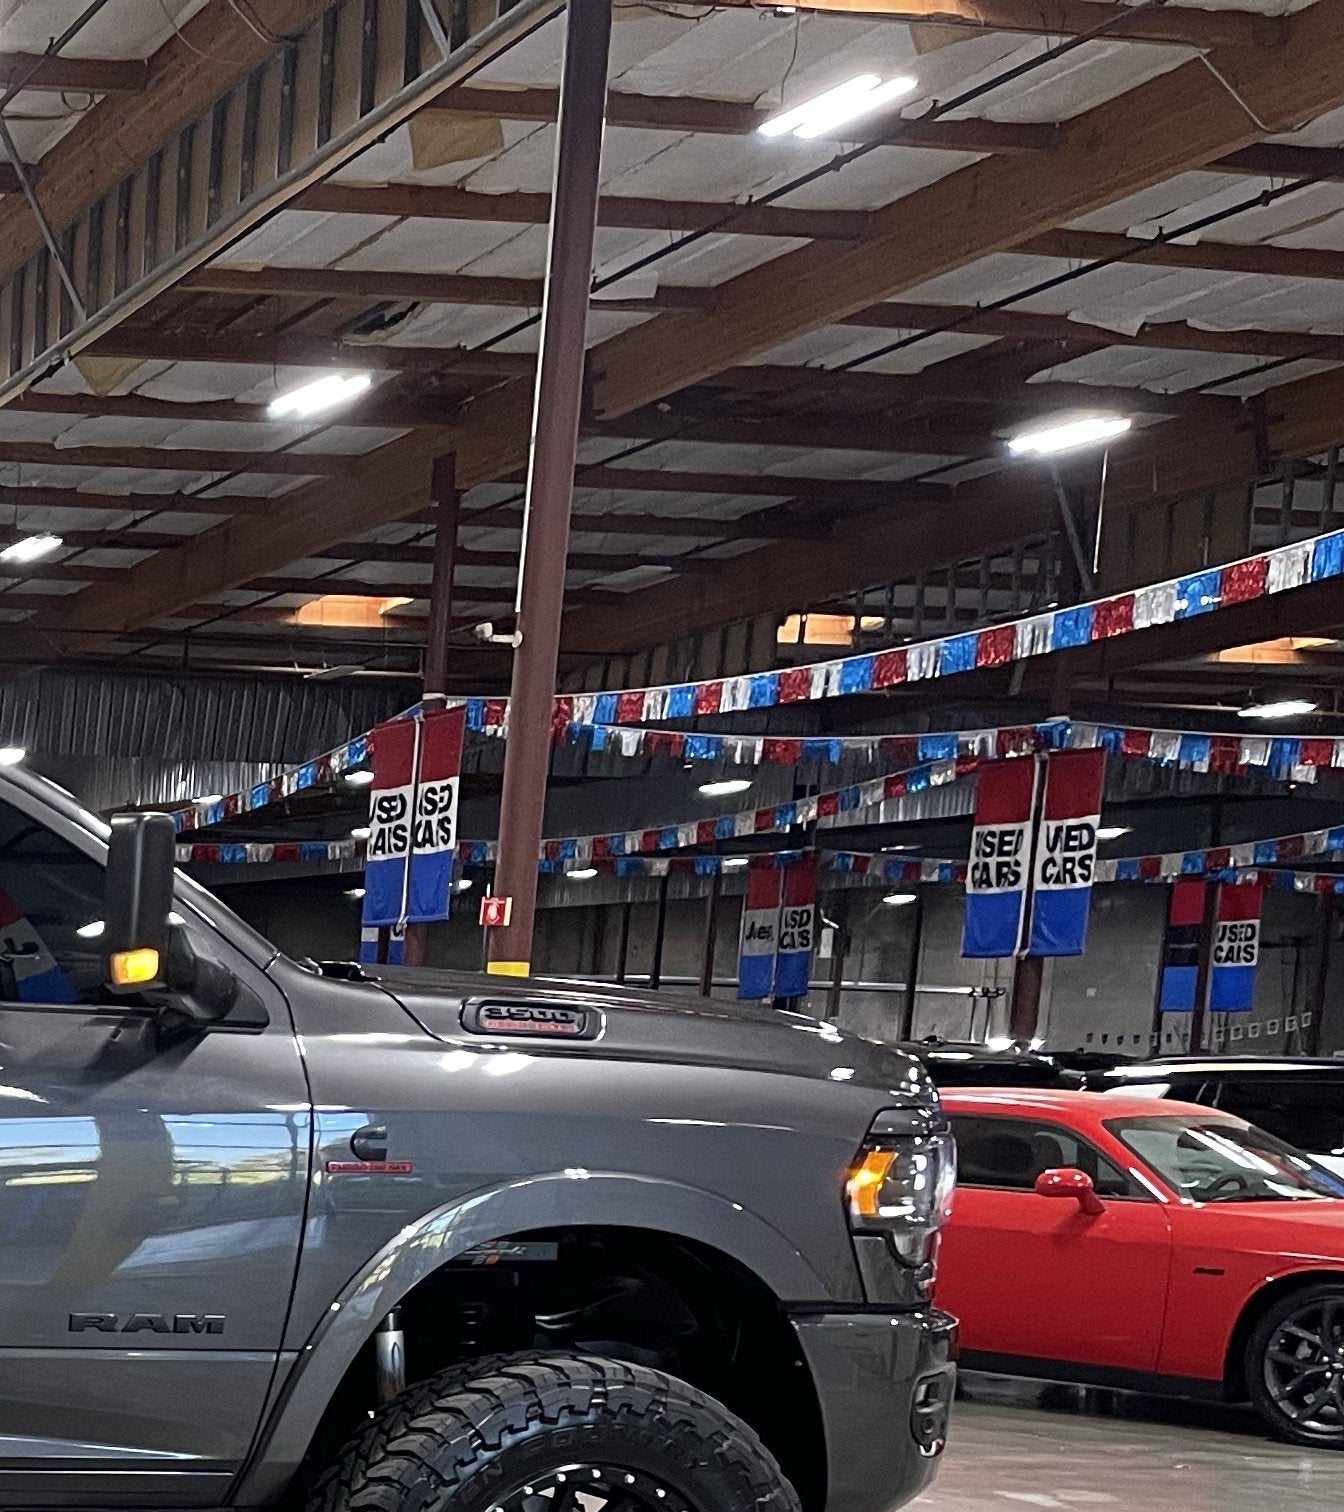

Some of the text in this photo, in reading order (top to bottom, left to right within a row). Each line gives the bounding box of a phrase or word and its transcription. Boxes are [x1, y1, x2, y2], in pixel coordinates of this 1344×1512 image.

[370, 793, 408, 824] SED
[419, 783, 453, 817] SD
[369, 824, 408, 855] AS
[414, 816, 452, 848] CAS
[1046, 823, 1096, 853] UED
[785, 909, 812, 929] SD
[779, 929, 811, 950] CS
[68, 1312, 226, 1335] RAM
